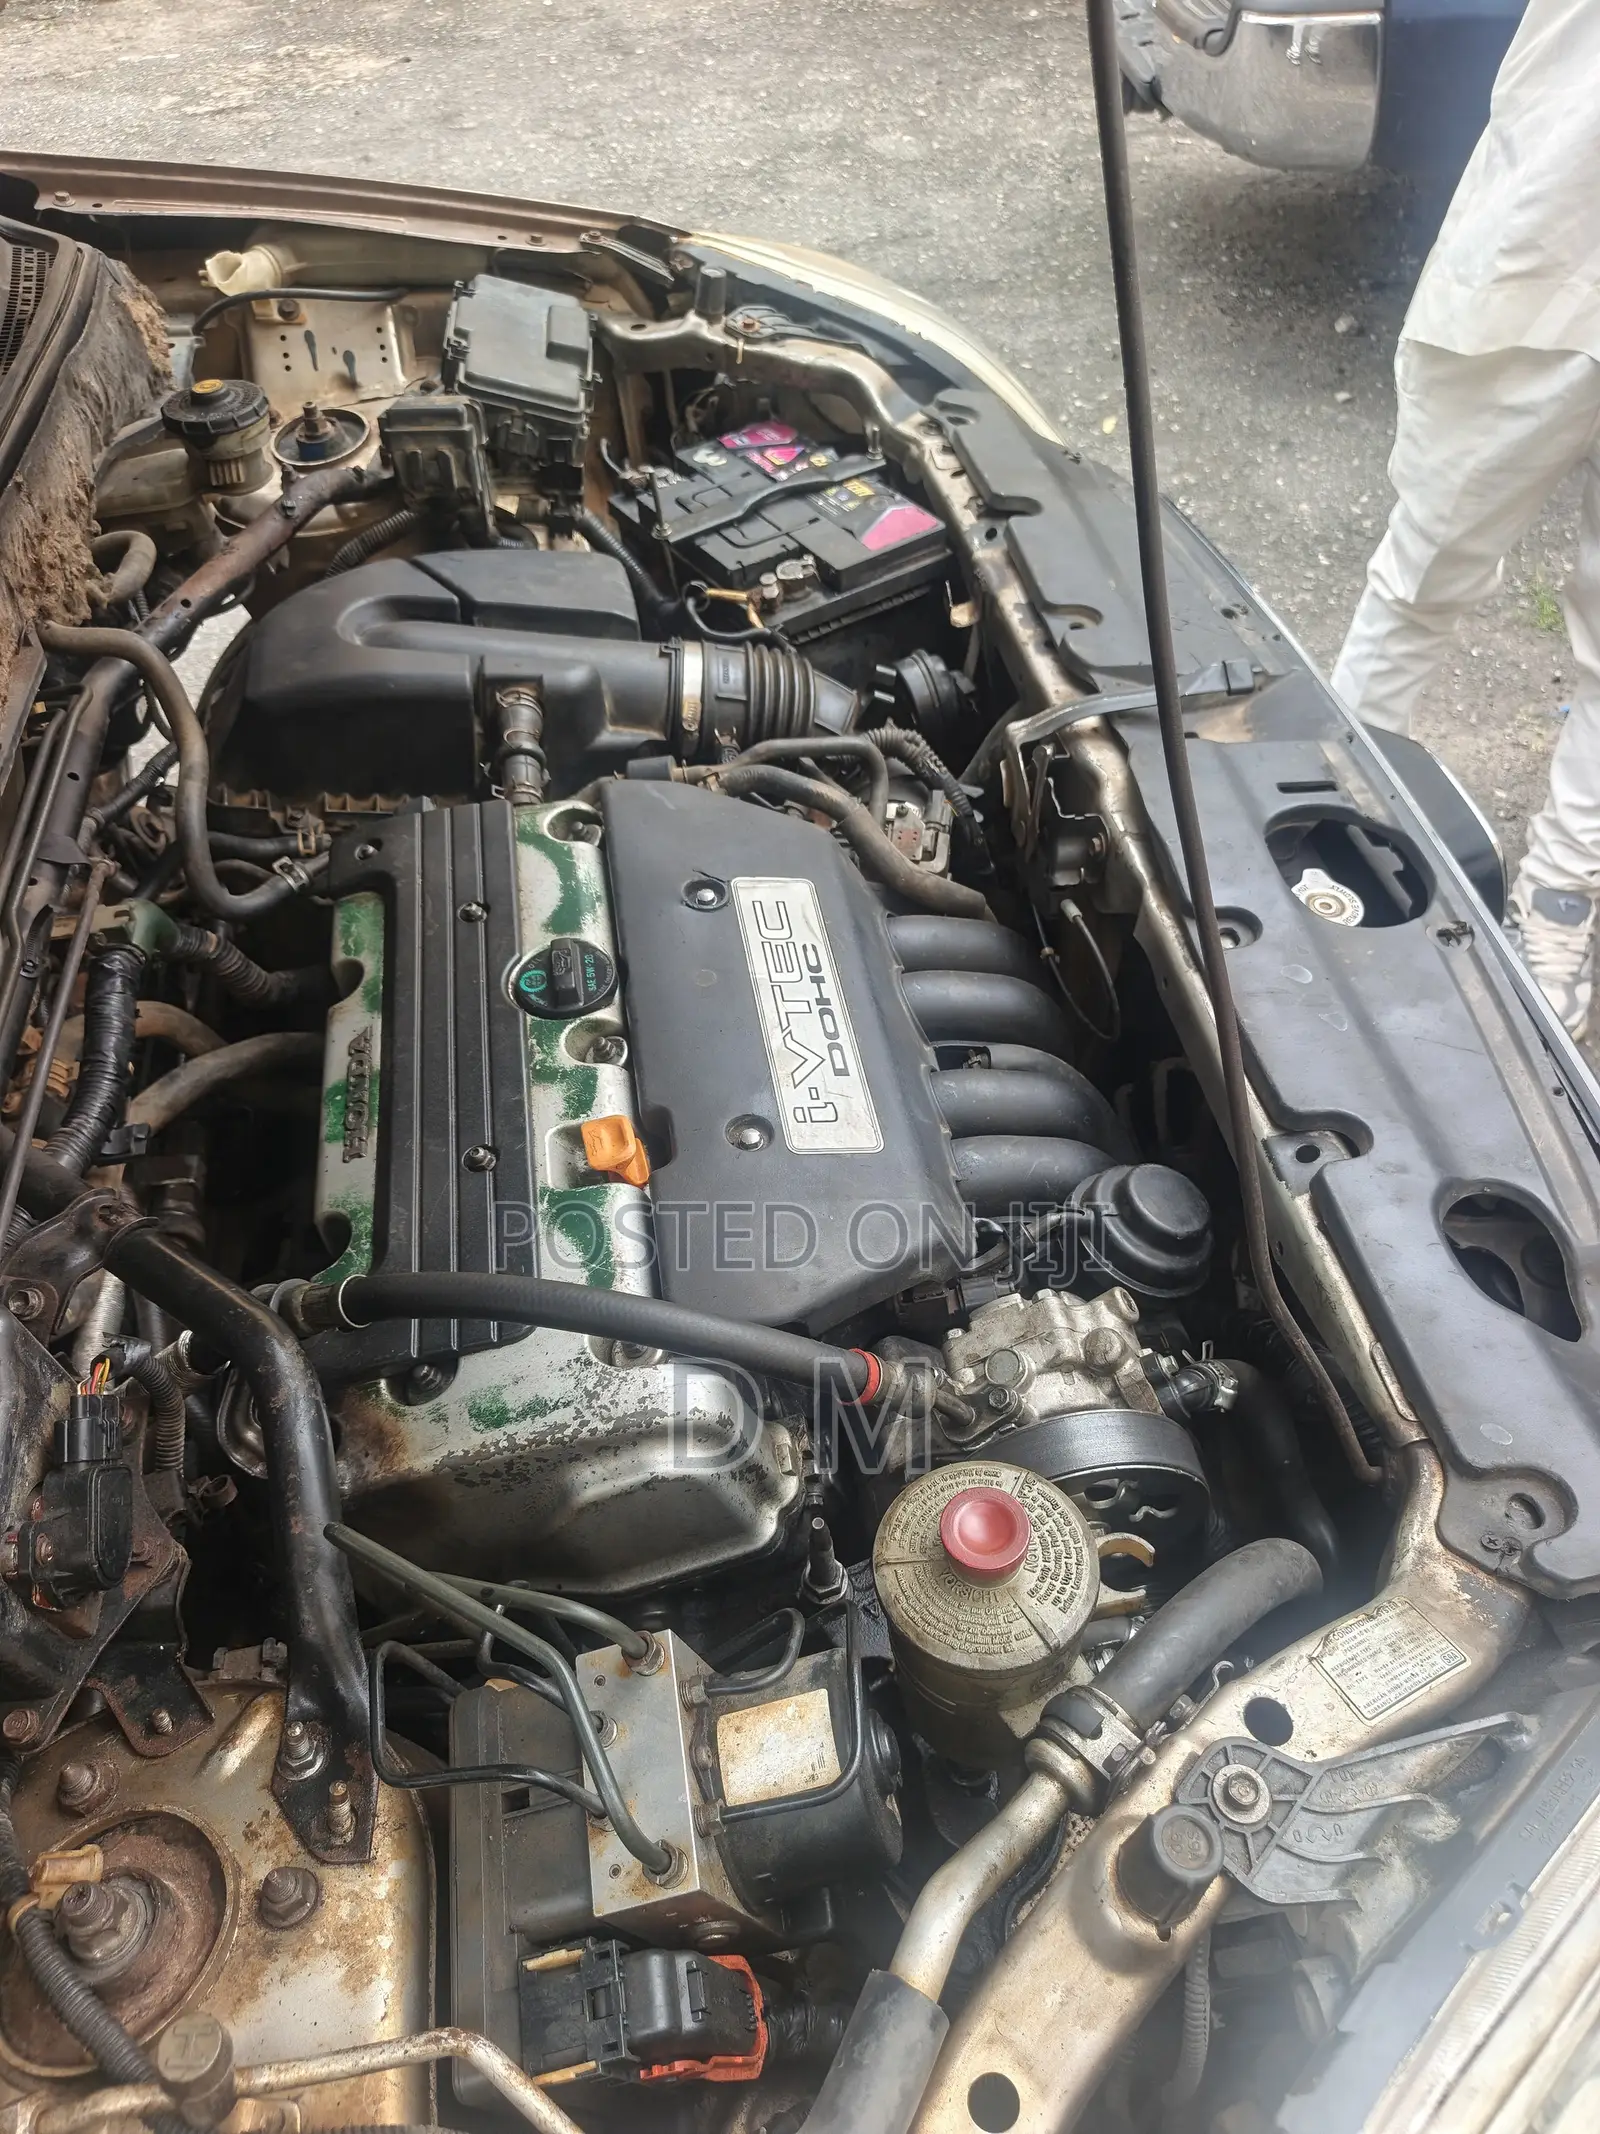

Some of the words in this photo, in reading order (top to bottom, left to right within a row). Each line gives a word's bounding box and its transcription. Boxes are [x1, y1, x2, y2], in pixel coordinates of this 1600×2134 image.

[752, 900, 838, 1124] i-VTEC
[802, 943, 850, 1077] DOHC
[342, 1025, 373, 1164] HONDA
[1036, 1532, 1050, 1563] HONDA
[1035, 1564, 1051, 1584] Only
[1035, 1580, 1056, 1606] Power
[1442, 1651, 1459, 1665] S9A
